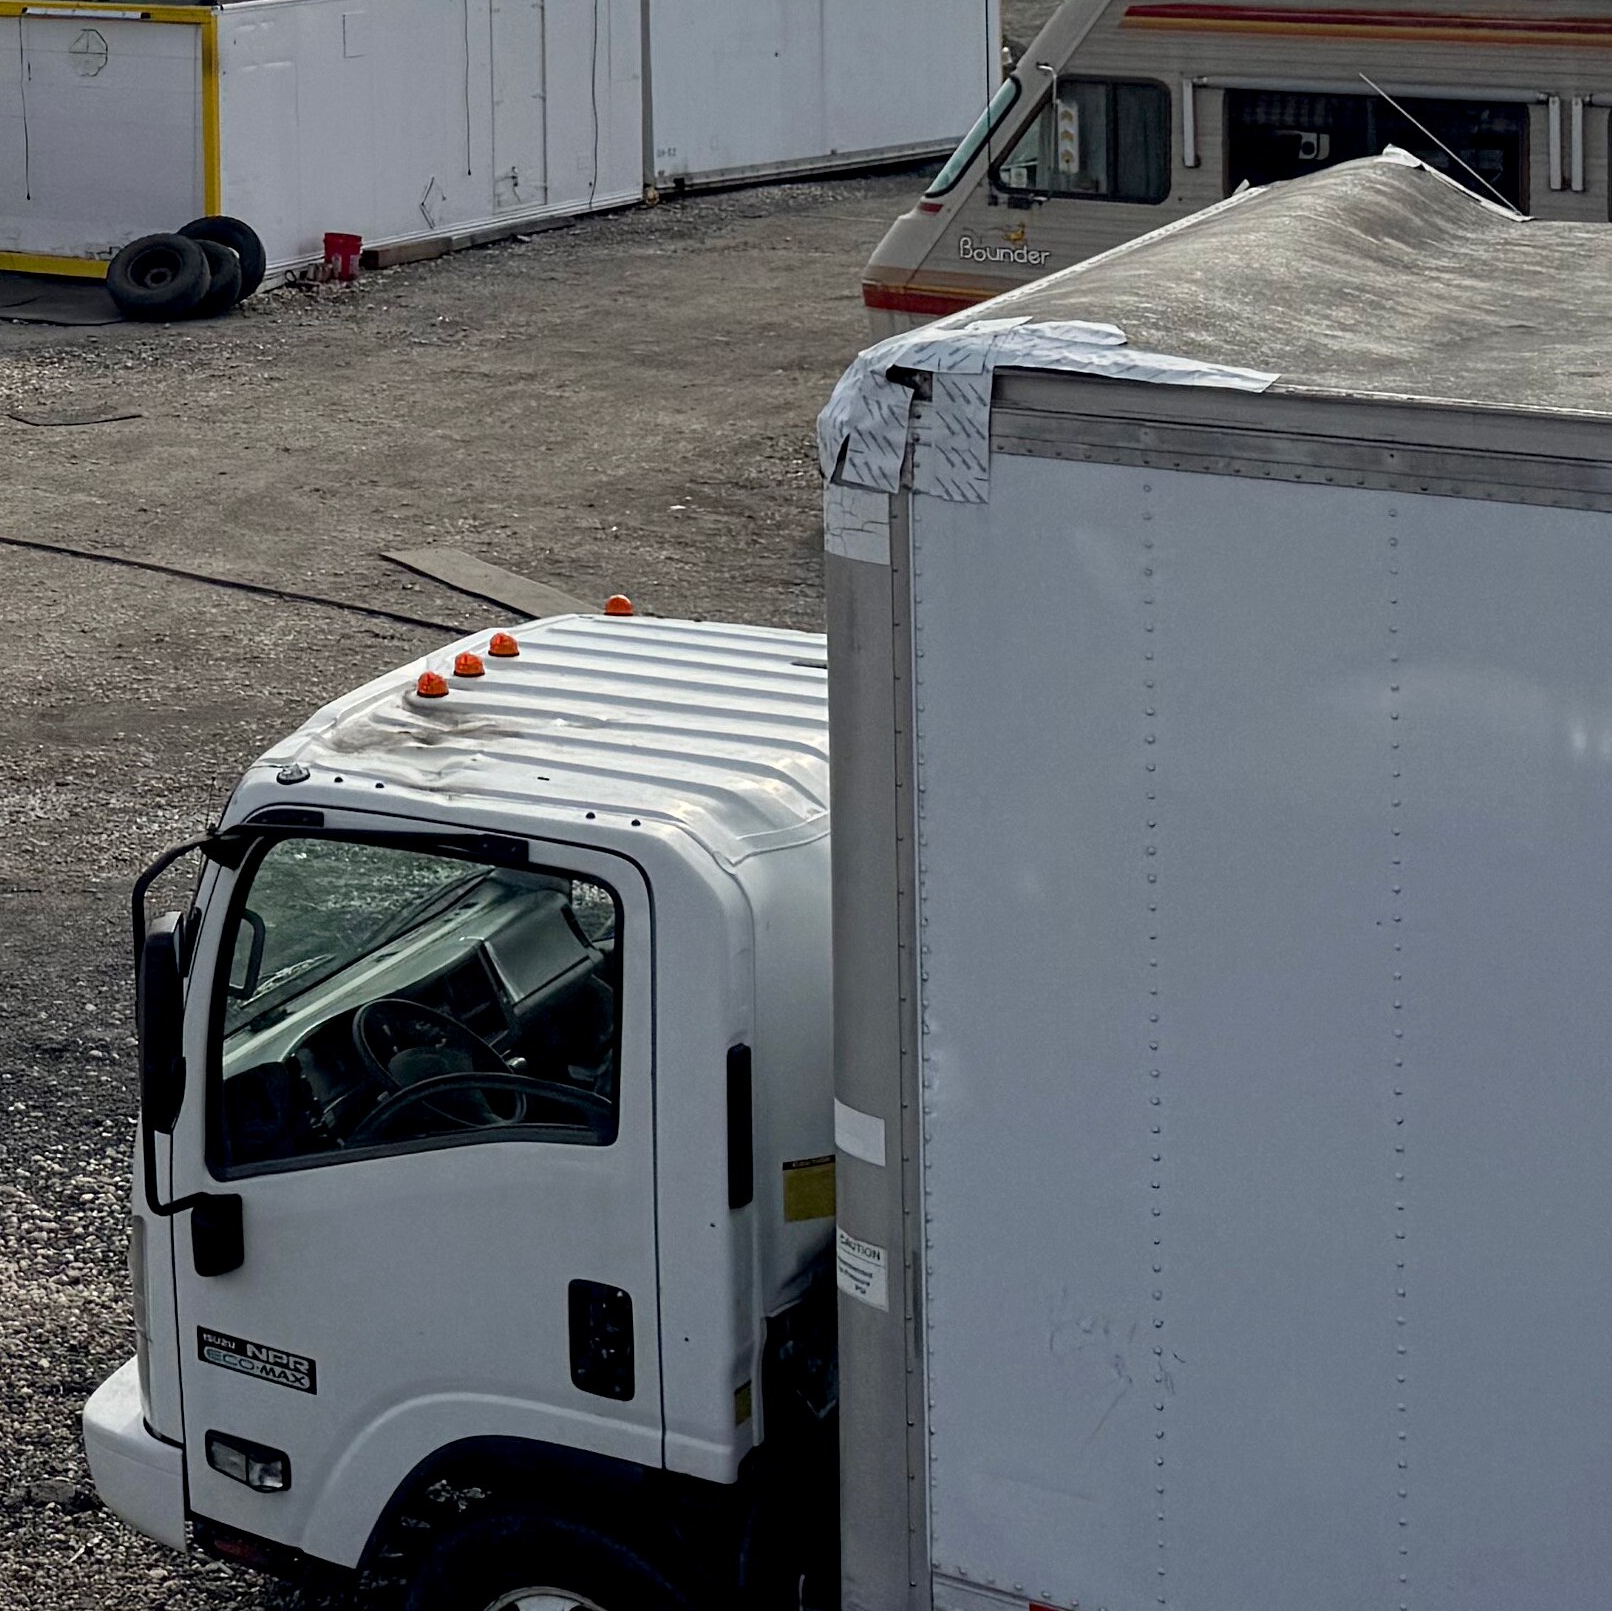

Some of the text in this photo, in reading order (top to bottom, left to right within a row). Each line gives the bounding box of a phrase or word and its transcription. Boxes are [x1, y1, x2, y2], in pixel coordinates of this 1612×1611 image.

[959, 236, 1051, 265] Bounder
[840, 1234, 881, 1261] CAUTION
[203, 1333, 309, 1373] ISUZU NPR
